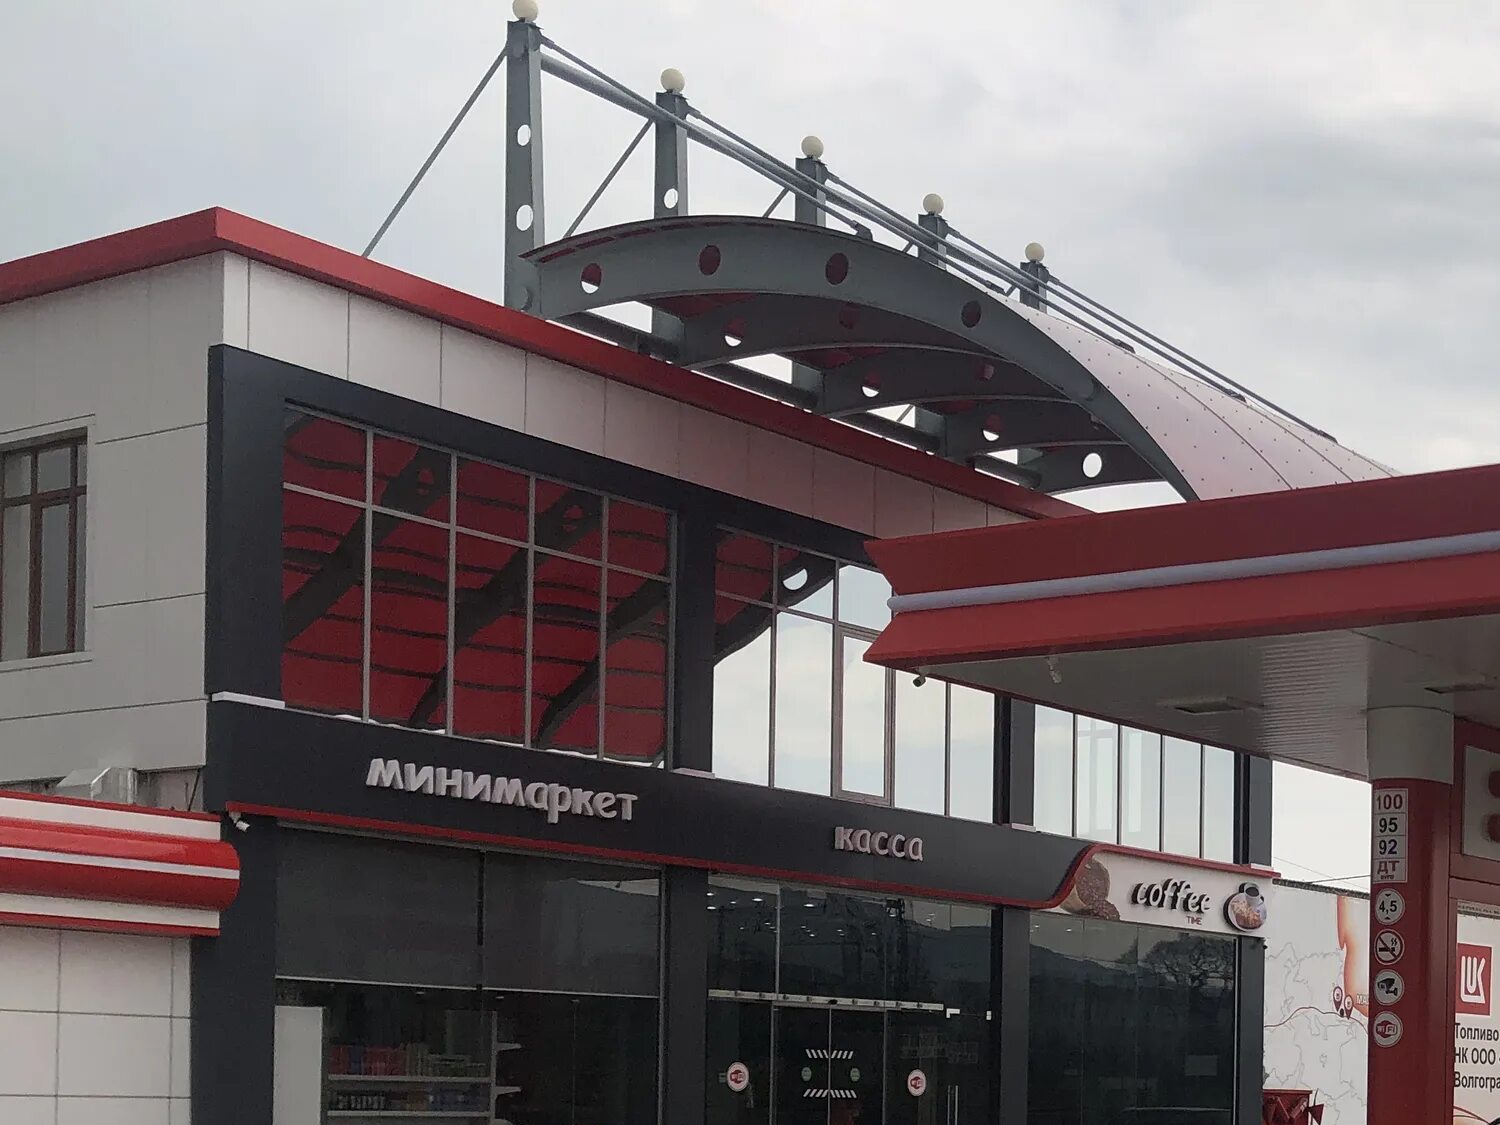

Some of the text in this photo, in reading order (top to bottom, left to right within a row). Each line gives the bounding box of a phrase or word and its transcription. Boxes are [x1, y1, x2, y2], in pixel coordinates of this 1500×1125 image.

[366, 757, 638, 823] минимаркет
[1376, 793, 1403, 810] 100
[1379, 817, 1398, 833] 95
[835, 826, 923, 861] касса
[1379, 839, 1397, 855] 92
[1377, 861, 1399, 874] ДТ
[1132, 878, 1210, 913] coffee
[1379, 900, 1397, 914] 4,5
[1454, 1023, 1499, 1042] Топливо
[1454, 1047, 1468, 1064] НК
[1471, 1048, 1496, 1065] ООО
